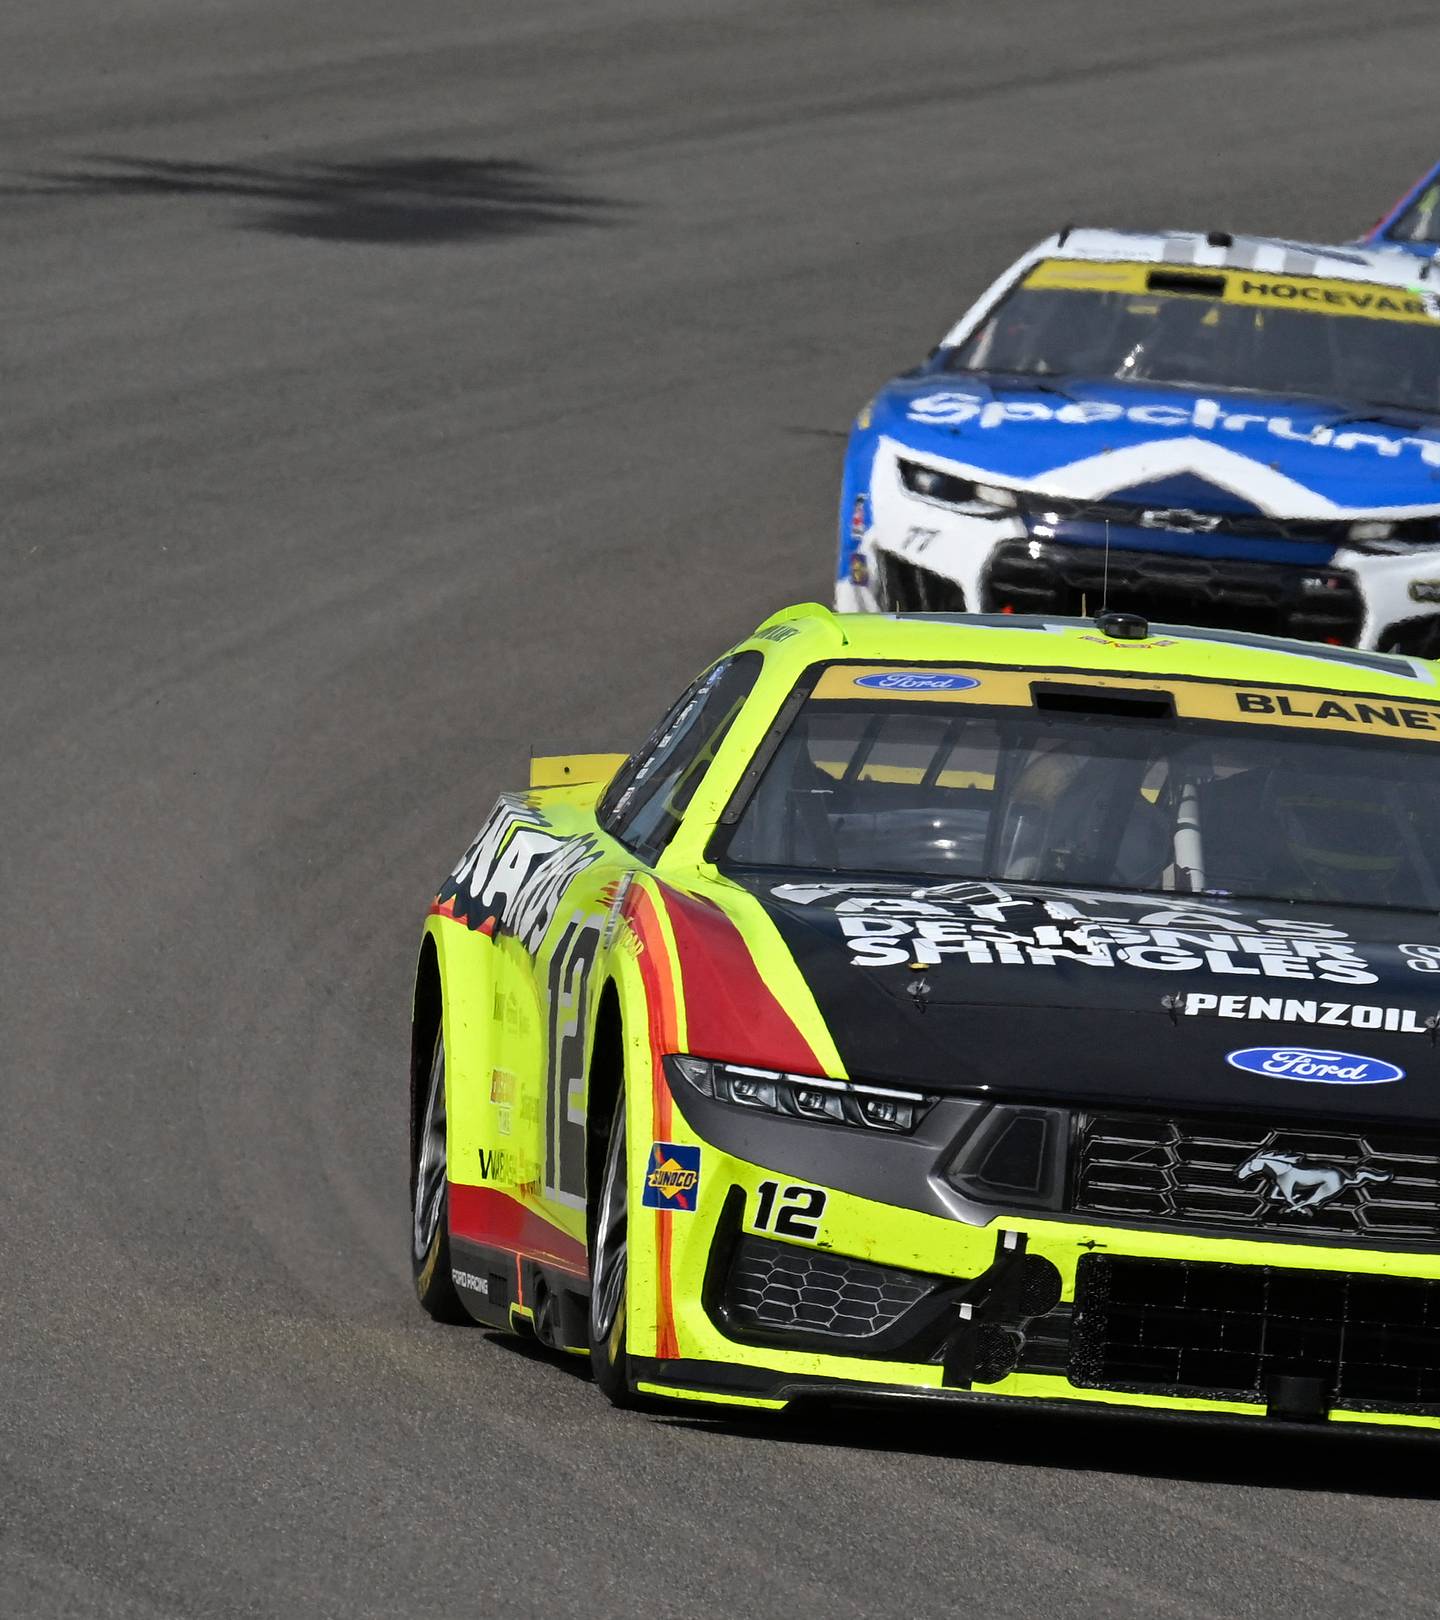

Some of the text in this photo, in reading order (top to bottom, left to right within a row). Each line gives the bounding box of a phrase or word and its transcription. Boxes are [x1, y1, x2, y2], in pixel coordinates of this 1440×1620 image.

[1241, 279, 1428, 314] HOCEVAR
[902, 526, 942, 554] 77
[879, 673, 955, 689] Ford
[838, 917, 1367, 963] DESIGNER
[846, 937, 1379, 985] SHINGLES
[1184, 993, 1428, 1033] PENNZOIL
[545, 920, 601, 1200] 12
[1262, 1051, 1369, 1081] Ford
[651, 1170, 696, 1188] SUNOCO
[754, 1181, 827, 1240] 12
[452, 1268, 489, 1295] FORD RACING
